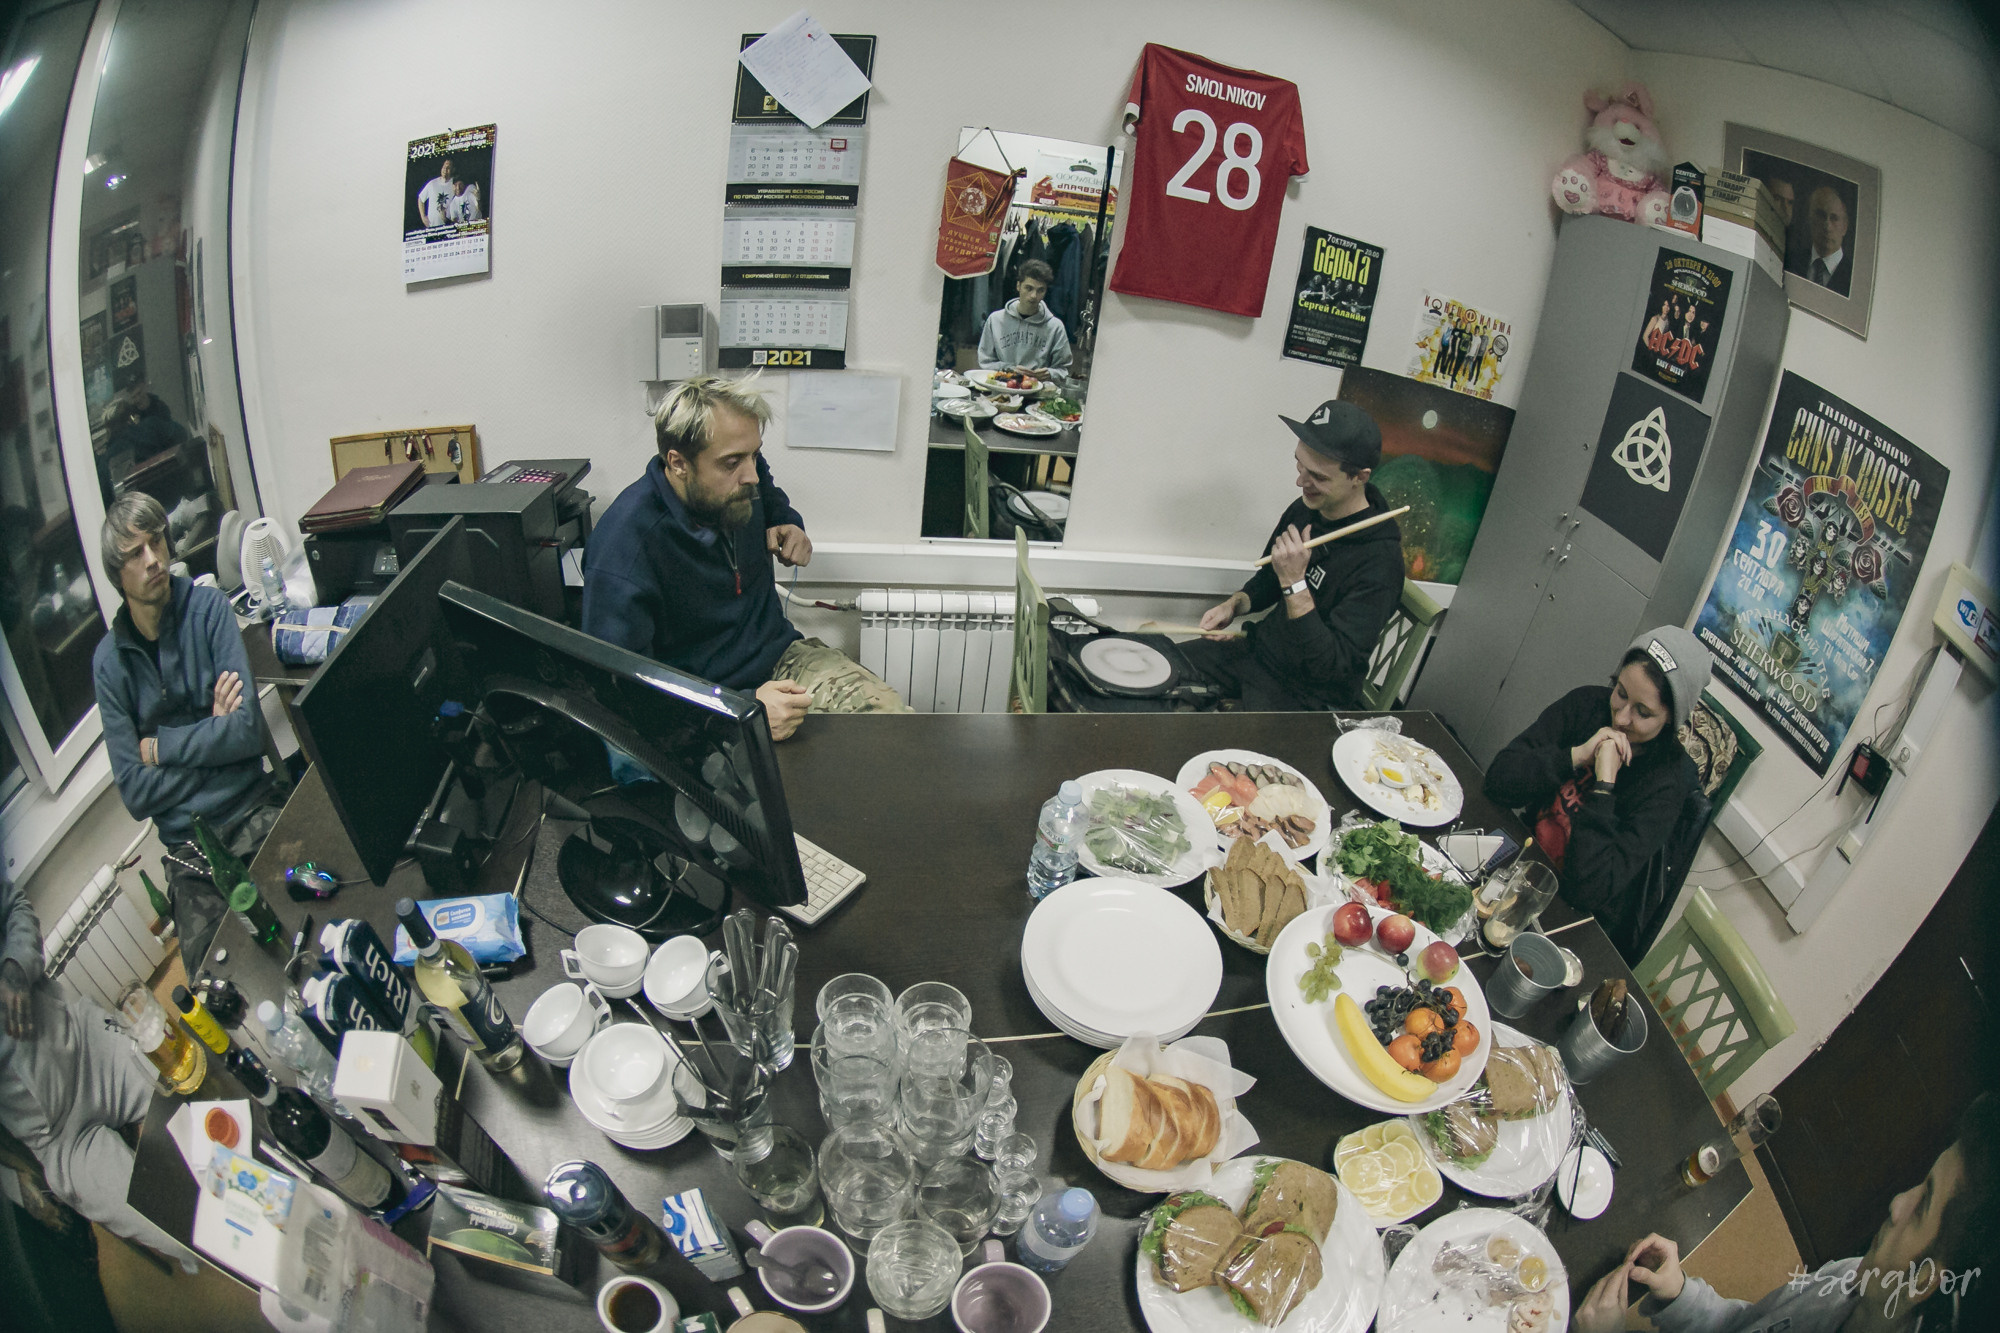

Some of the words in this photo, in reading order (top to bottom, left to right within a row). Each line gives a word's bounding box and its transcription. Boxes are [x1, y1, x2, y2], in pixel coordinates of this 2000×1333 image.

[1185, 73, 1267, 111] SMOLNIKOV
[410, 143, 436, 159] 2021
[1165, 109, 1263, 211] 28
[1717, 179, 1746, 193] СТАНДАРТ
[1721, 171, 1751, 184] СТАНДАРТ
[1712, 189, 1741, 203] СТАНДАРТ
[1673, 257, 1701, 272] ОКТЯБРЯ
[1707, 269, 1722, 288] 21:00
[1298, 298, 1330, 313] Сергей
[1331, 306, 1366, 322] Галанин
[1465, 309, 1512, 336] ФИЛЬМА
[767, 350, 812, 366] 2021
[1818, 400, 1873, 442] TRIBUTE
[1874, 435, 1912, 467] SHOW
[1786, 407, 1841, 475] GUNS
[1855, 447, 1921, 535] ROSES
[1750, 519, 1787, 569] 30
[1730, 628, 1818, 713] SHERWOOD
[450, 907, 472, 917] Салфетки
[365, 943, 409, 1013] Rich
